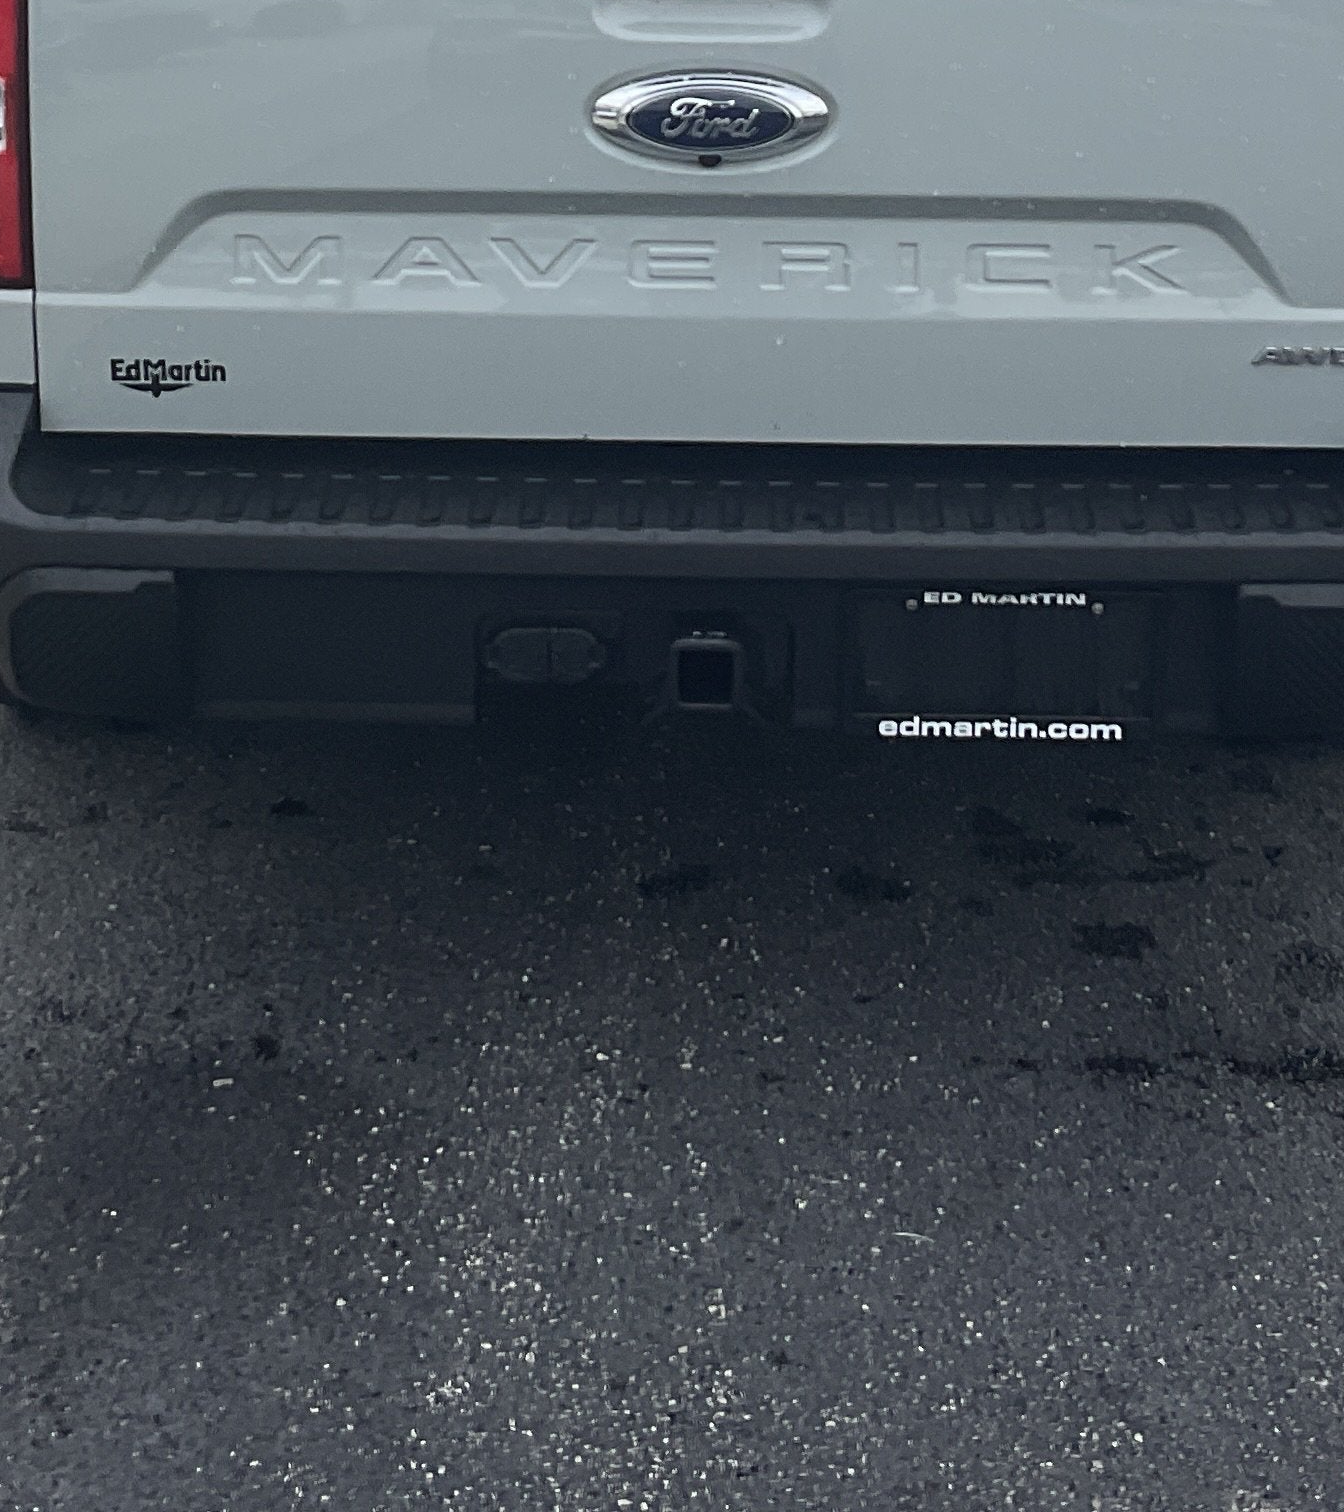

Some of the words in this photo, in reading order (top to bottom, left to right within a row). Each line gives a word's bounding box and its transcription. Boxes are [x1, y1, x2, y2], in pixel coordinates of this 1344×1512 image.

[660, 96, 761, 139] Ford
[230, 233, 1186, 293] MAVERICK
[923, 591, 963, 604] ED
[971, 592, 1087, 606] MARTIN
[878, 715, 1123, 741] edmartin.com
